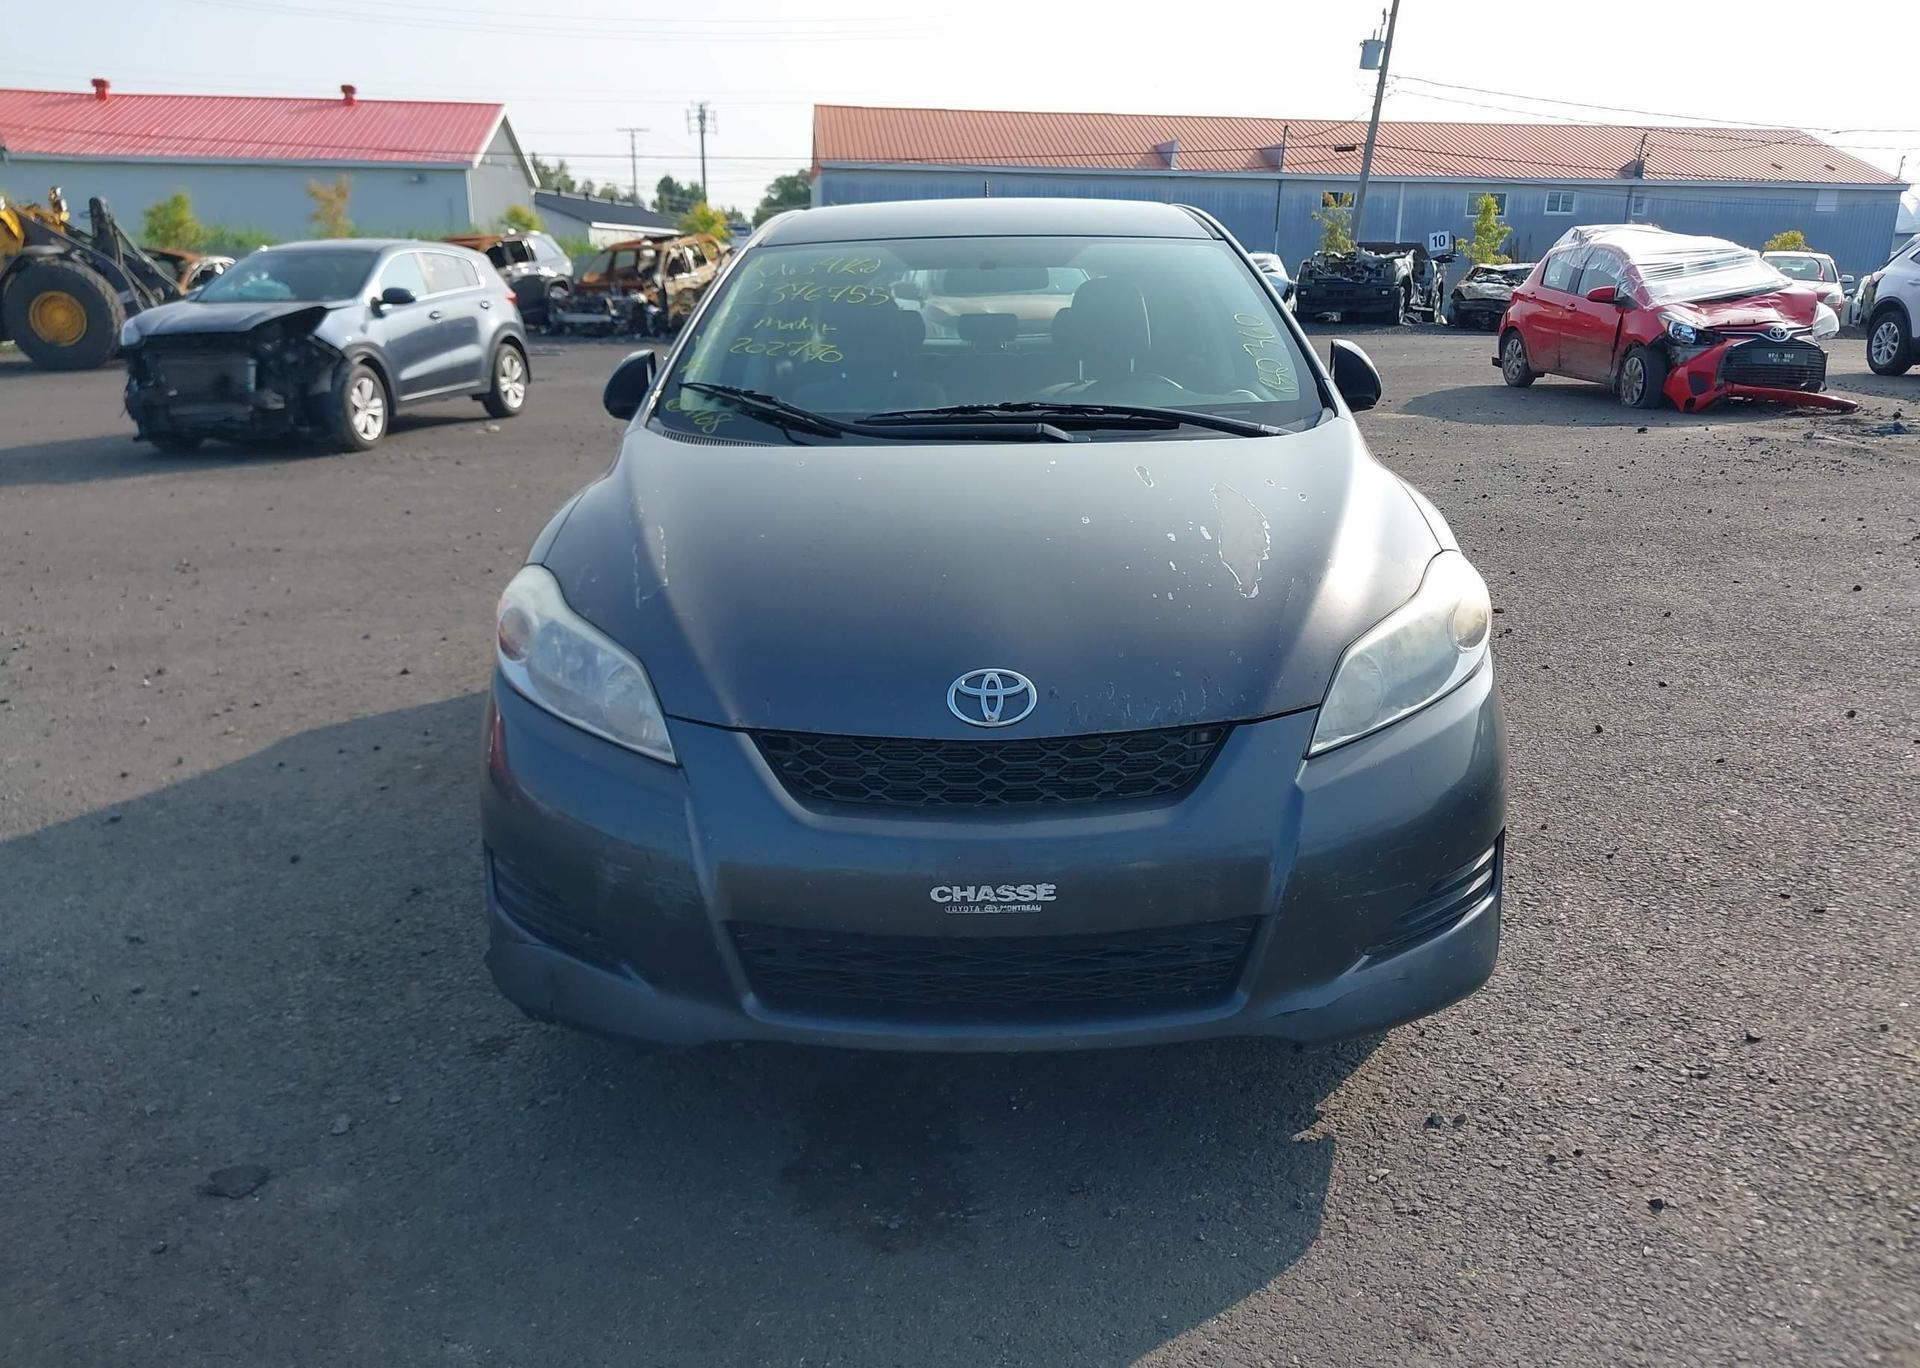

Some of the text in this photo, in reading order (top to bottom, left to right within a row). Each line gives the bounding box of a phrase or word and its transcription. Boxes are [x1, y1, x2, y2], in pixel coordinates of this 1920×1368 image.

[1432, 234, 1446, 248] 10
[930, 883, 1057, 903] CHASSE
[946, 904, 980, 913] TOYOTA
